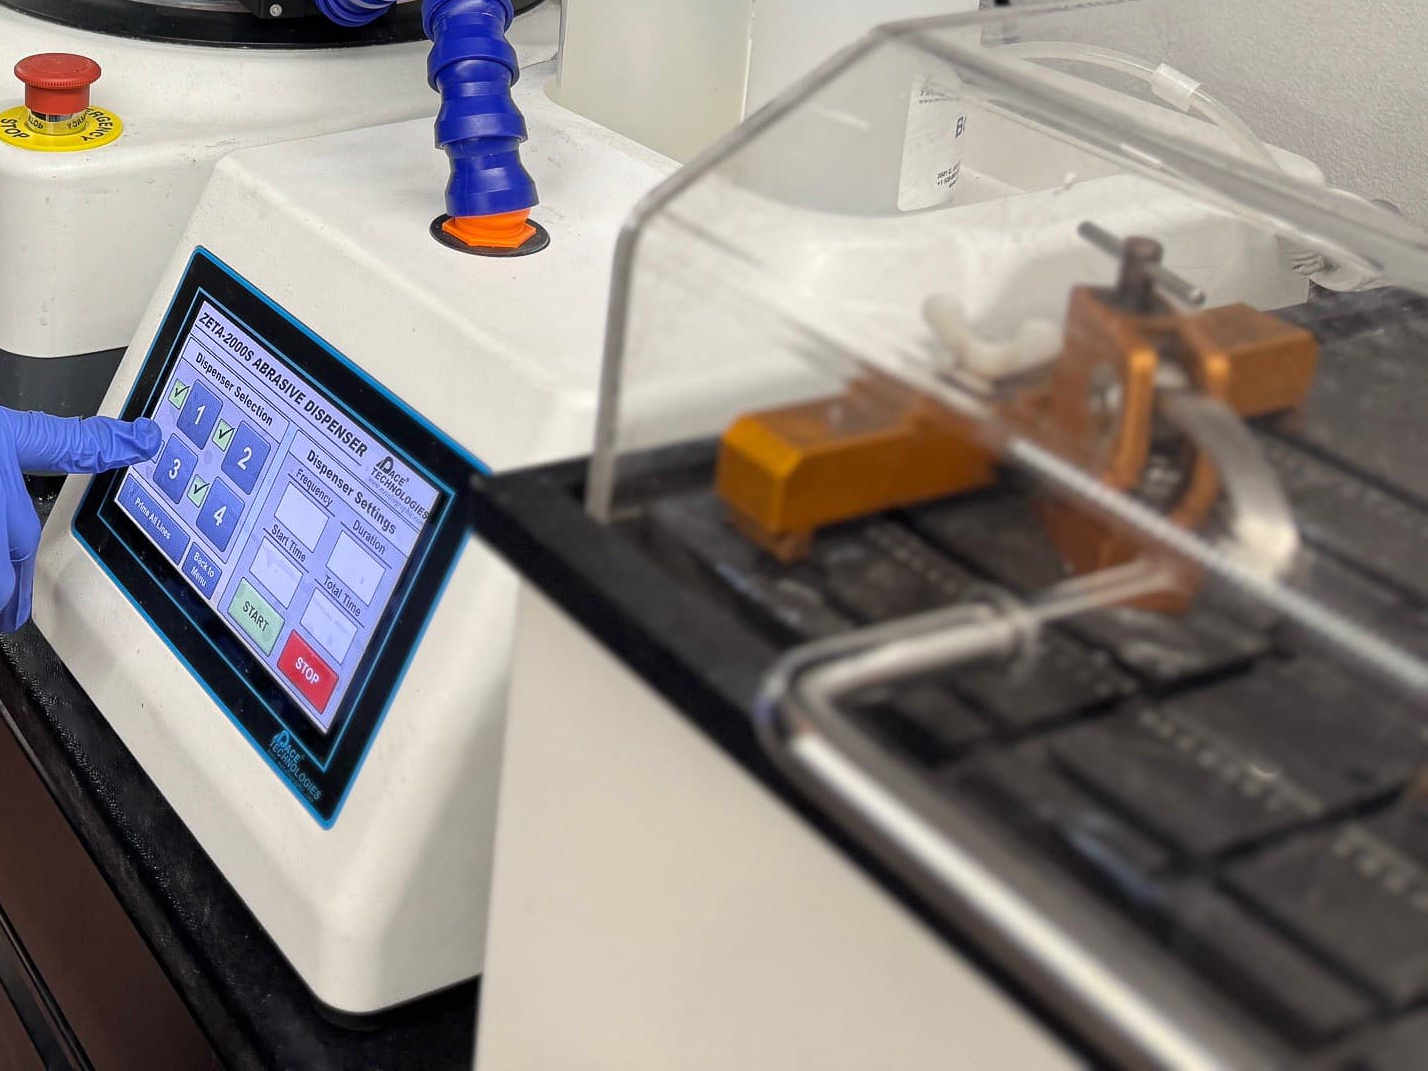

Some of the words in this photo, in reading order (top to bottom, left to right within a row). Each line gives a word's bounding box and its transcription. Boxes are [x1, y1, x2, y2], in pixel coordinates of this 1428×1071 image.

[0, 118, 30, 140] STOP
[195, 352, 235, 393] Dispenser
[233, 386, 273, 427] Selection
[198, 312, 256, 363] ZETA-2000S
[252, 358, 307, 406] ABRASIVE
[304, 400, 369, 458] DISPENSER
[194, 404, 206, 426] 1
[168, 458, 182, 480] 3
[237, 446, 254, 471] 2
[375, 456, 406, 487] PACE
[295, 468, 334, 508] Frequency
[306, 449, 354, 496] Dispenser
[354, 491, 397, 536] Settings
[371, 466, 429, 520] TECHNOLOGIES
[134, 497, 150, 517] Prime
[213, 505, 228, 527] 4
[271, 523, 290, 547] Start
[288, 540, 307, 563] Time
[352, 519, 386, 555] Duration
[191, 566, 207, 587] Menu
[194, 551, 208, 572] Back
[207, 566, 215, 578] to
[323, 574, 343, 600] Total
[342, 593, 362, 617] Time
[242, 601, 270, 632] START
[295, 656, 320, 685] STOP
[269, 739, 322, 800] TECHNOLOGIES
